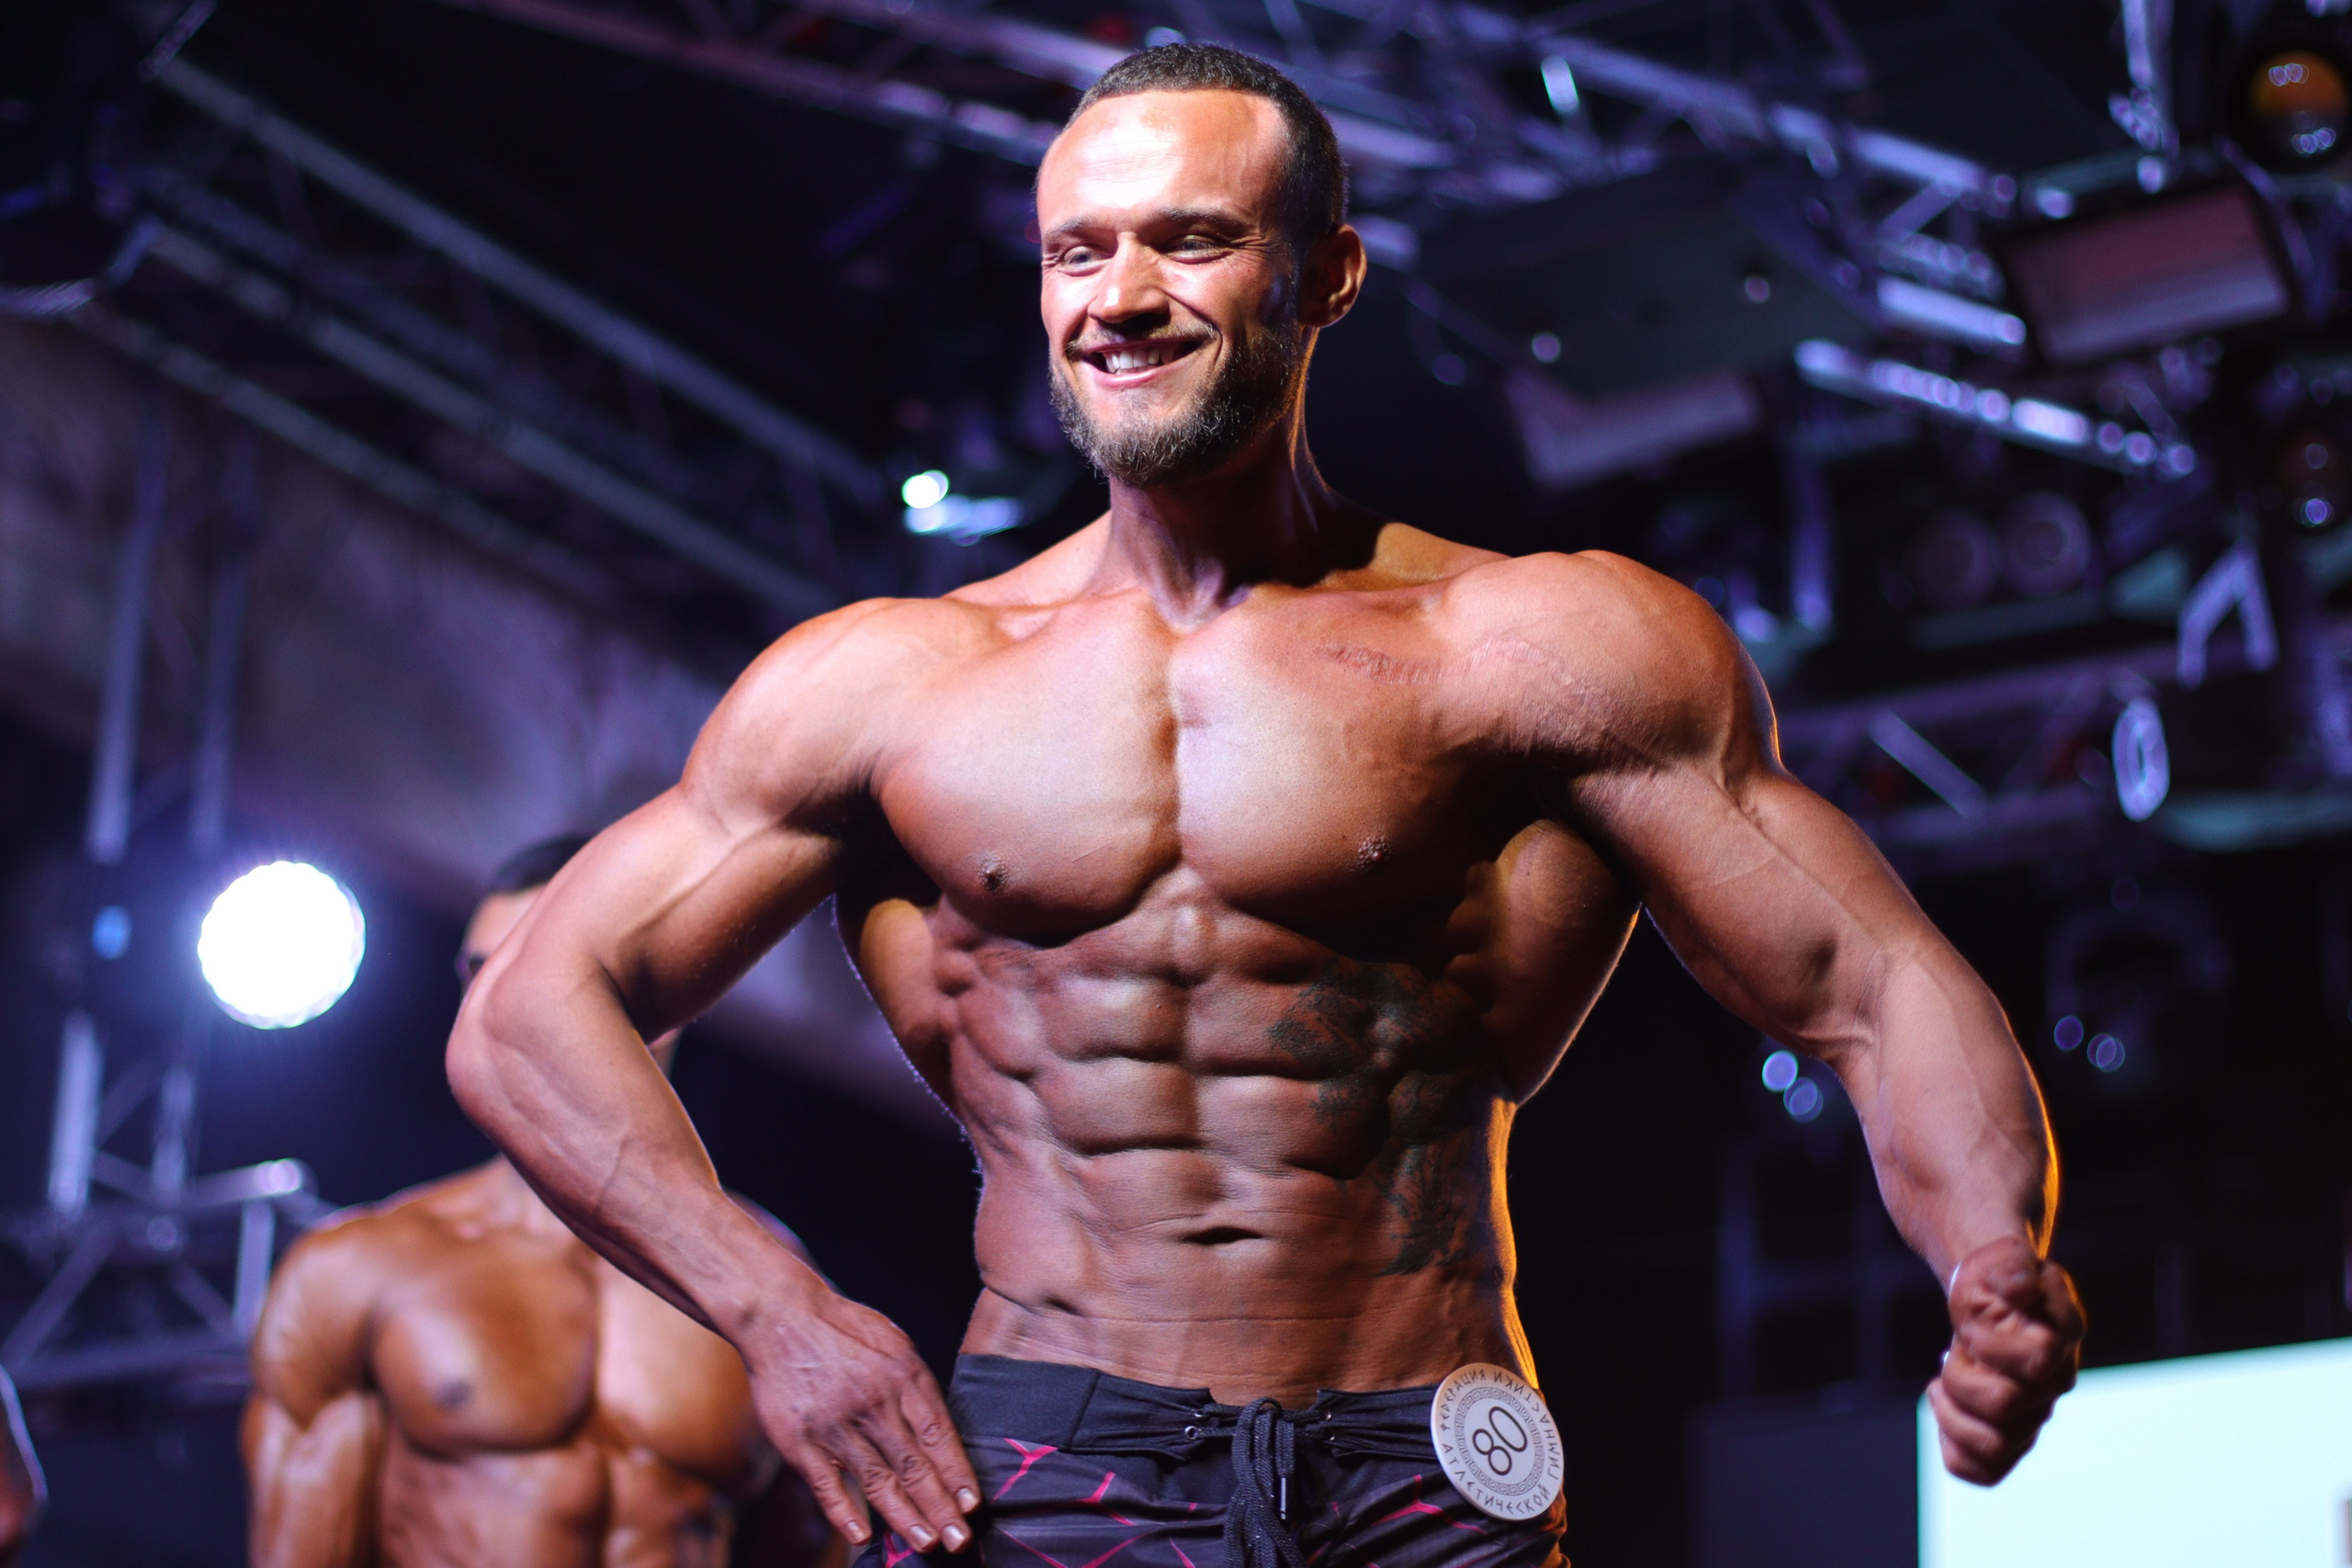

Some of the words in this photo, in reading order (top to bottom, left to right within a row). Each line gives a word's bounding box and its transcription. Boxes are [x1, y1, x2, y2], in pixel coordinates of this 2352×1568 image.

[1440, 1369, 1487, 1432] ФЕДЕРАЦИЯ
[1493, 1371, 1560, 1481] ГИМНАСТИКИ
[1473, 1406, 1527, 1476] 80
[1442, 1444, 1551, 1515] АТЛЕТИЧЕСКОЙ
